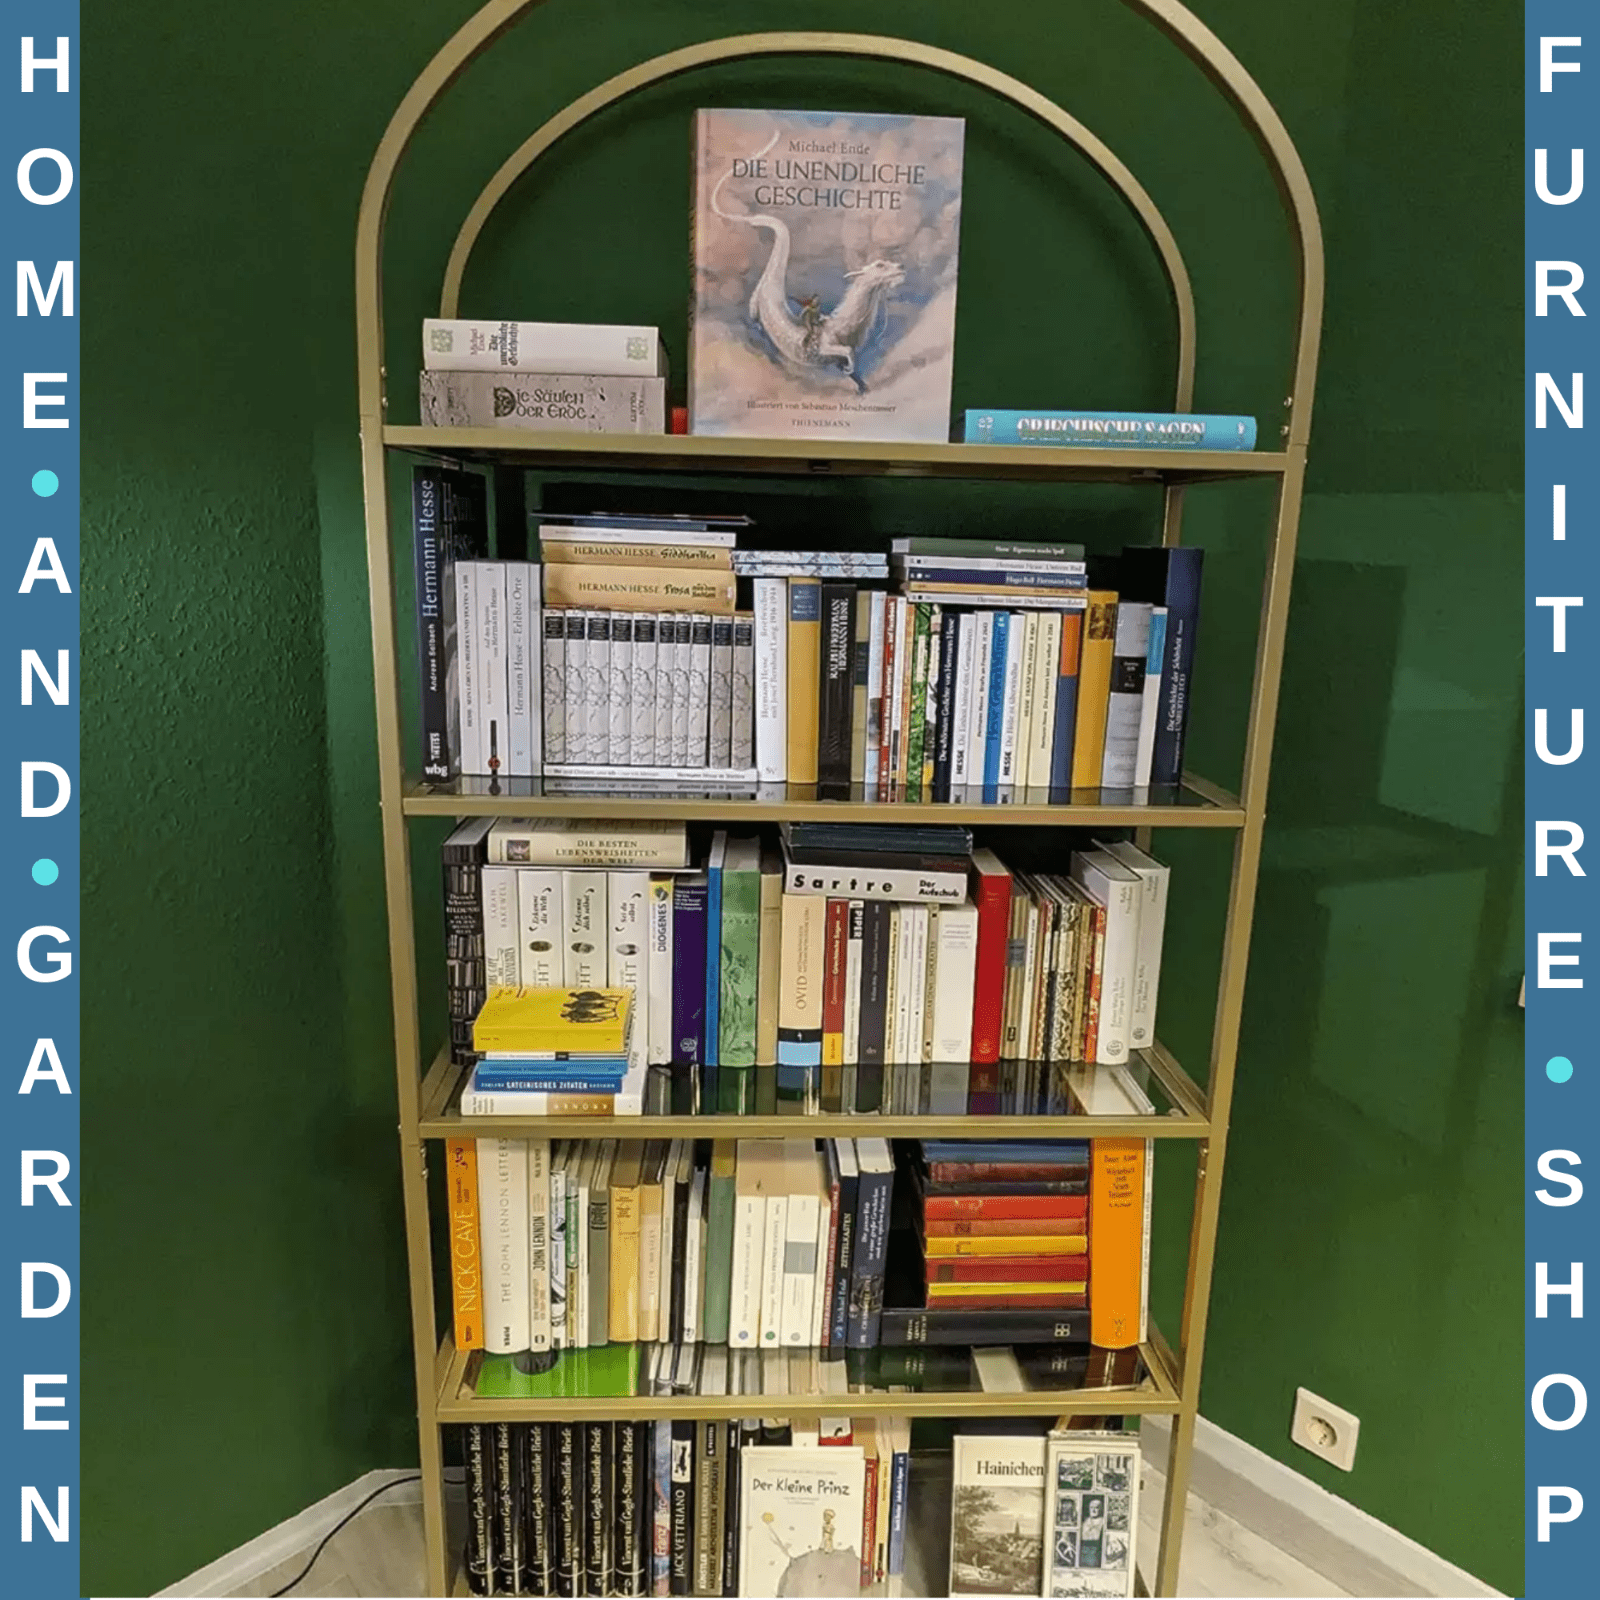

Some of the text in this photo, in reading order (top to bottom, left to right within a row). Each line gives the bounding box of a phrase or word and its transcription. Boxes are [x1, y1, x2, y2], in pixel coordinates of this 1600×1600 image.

[789, 141, 870, 154] Michael Ende
[732, 158, 925, 185] DIE UNENDLICHE
[755, 185, 901, 210] GESCHICHTE
[420, 480, 438, 617] Hermann Hesse
[574, 546, 655, 557] HERMANN HESSE
[578, 582, 690, 596] HERMANN HESSE Prosa
[513, 578, 524, 716] Hermann Hesse Erlebte Orte
[425, 765, 448, 777] wbg
[956, 750, 964, 774] HESSE
[1003, 751, 1012, 776] HESSE
[555, 848, 658, 857] LEBENSWEISHEITEN
[577, 840, 638, 848] DIE BESTEN
[794, 874, 893, 893] Sartre
[918, 889, 959, 897] Aufschub
[919, 880, 936, 888] Der
[540, 914, 548, 924] die
[658, 903, 666, 952] DIOGENES
[854, 910, 863, 938] PIPER
[796, 976, 807, 1010] OVID
[498, 1137, 511, 1302] THE JOHN LENNON LETTERS
[454, 1208, 475, 1258] CAVE
[532, 1216, 546, 1271] JOHN LENNON
[840, 1213, 851, 1268] ZETTELKASTEN
[457, 1263, 477, 1311] NICK
[470, 1426, 481, 1451] Briefe
[561, 1428, 572, 1454] Briefe
[590, 1427, 601, 1453] Briefe
[621, 1427, 633, 1453] Briefe
[701, 1461, 709, 1486] SOLLTE
[976, 1460, 1044, 1476] Hainichen
[753, 1478, 850, 1496] Der Kleine Prinz
[701, 1487, 709, 1517] KENNEN
[674, 1489, 685, 1577] JACK VETTRIANO
[700, 1518, 708, 1535] MAN
[475, 1534, 485, 1563] Vincent
[499, 1533, 511, 1561] Vincent
[533, 1535, 543, 1564] Vincent
[561, 1537, 571, 1567] Vincent
[591, 1536, 601, 1564] Vincent
[622, 1536, 632, 1565] Vincent
[655, 1528, 667, 1555] Franz
[698, 1553, 708, 1589] KÜNSTLER
